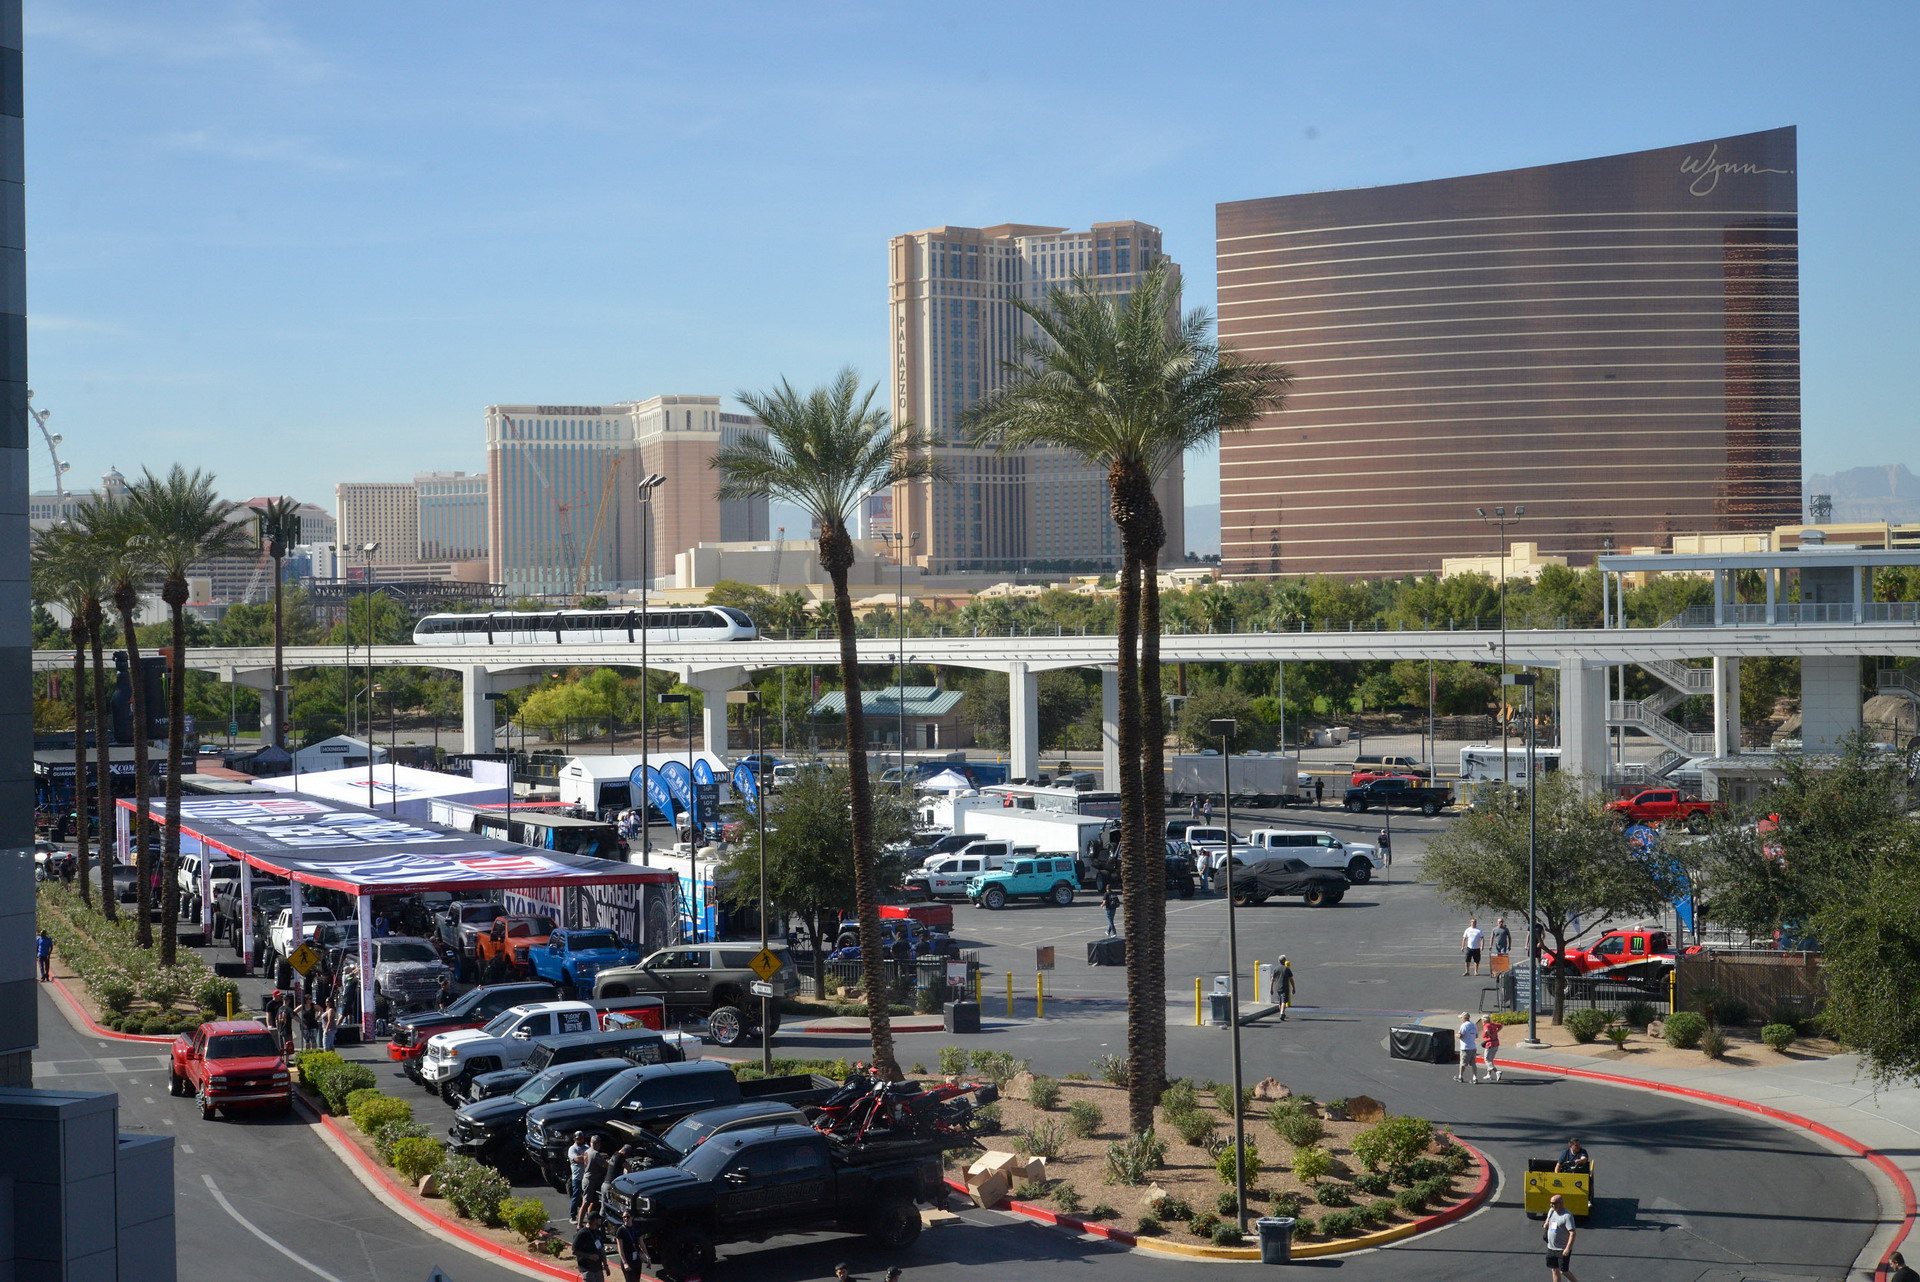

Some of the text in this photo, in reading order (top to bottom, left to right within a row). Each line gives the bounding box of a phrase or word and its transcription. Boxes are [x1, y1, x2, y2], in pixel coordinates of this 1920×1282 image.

[899, 316, 907, 409] PALAZZO
[537, 405, 602, 416] VENETIAN
[720, 413, 751, 424] ENETIAN
[705, 807, 711, 816] 3
[595, 883, 636, 908] FORGED
[597, 903, 636, 942] SINCE DAY
